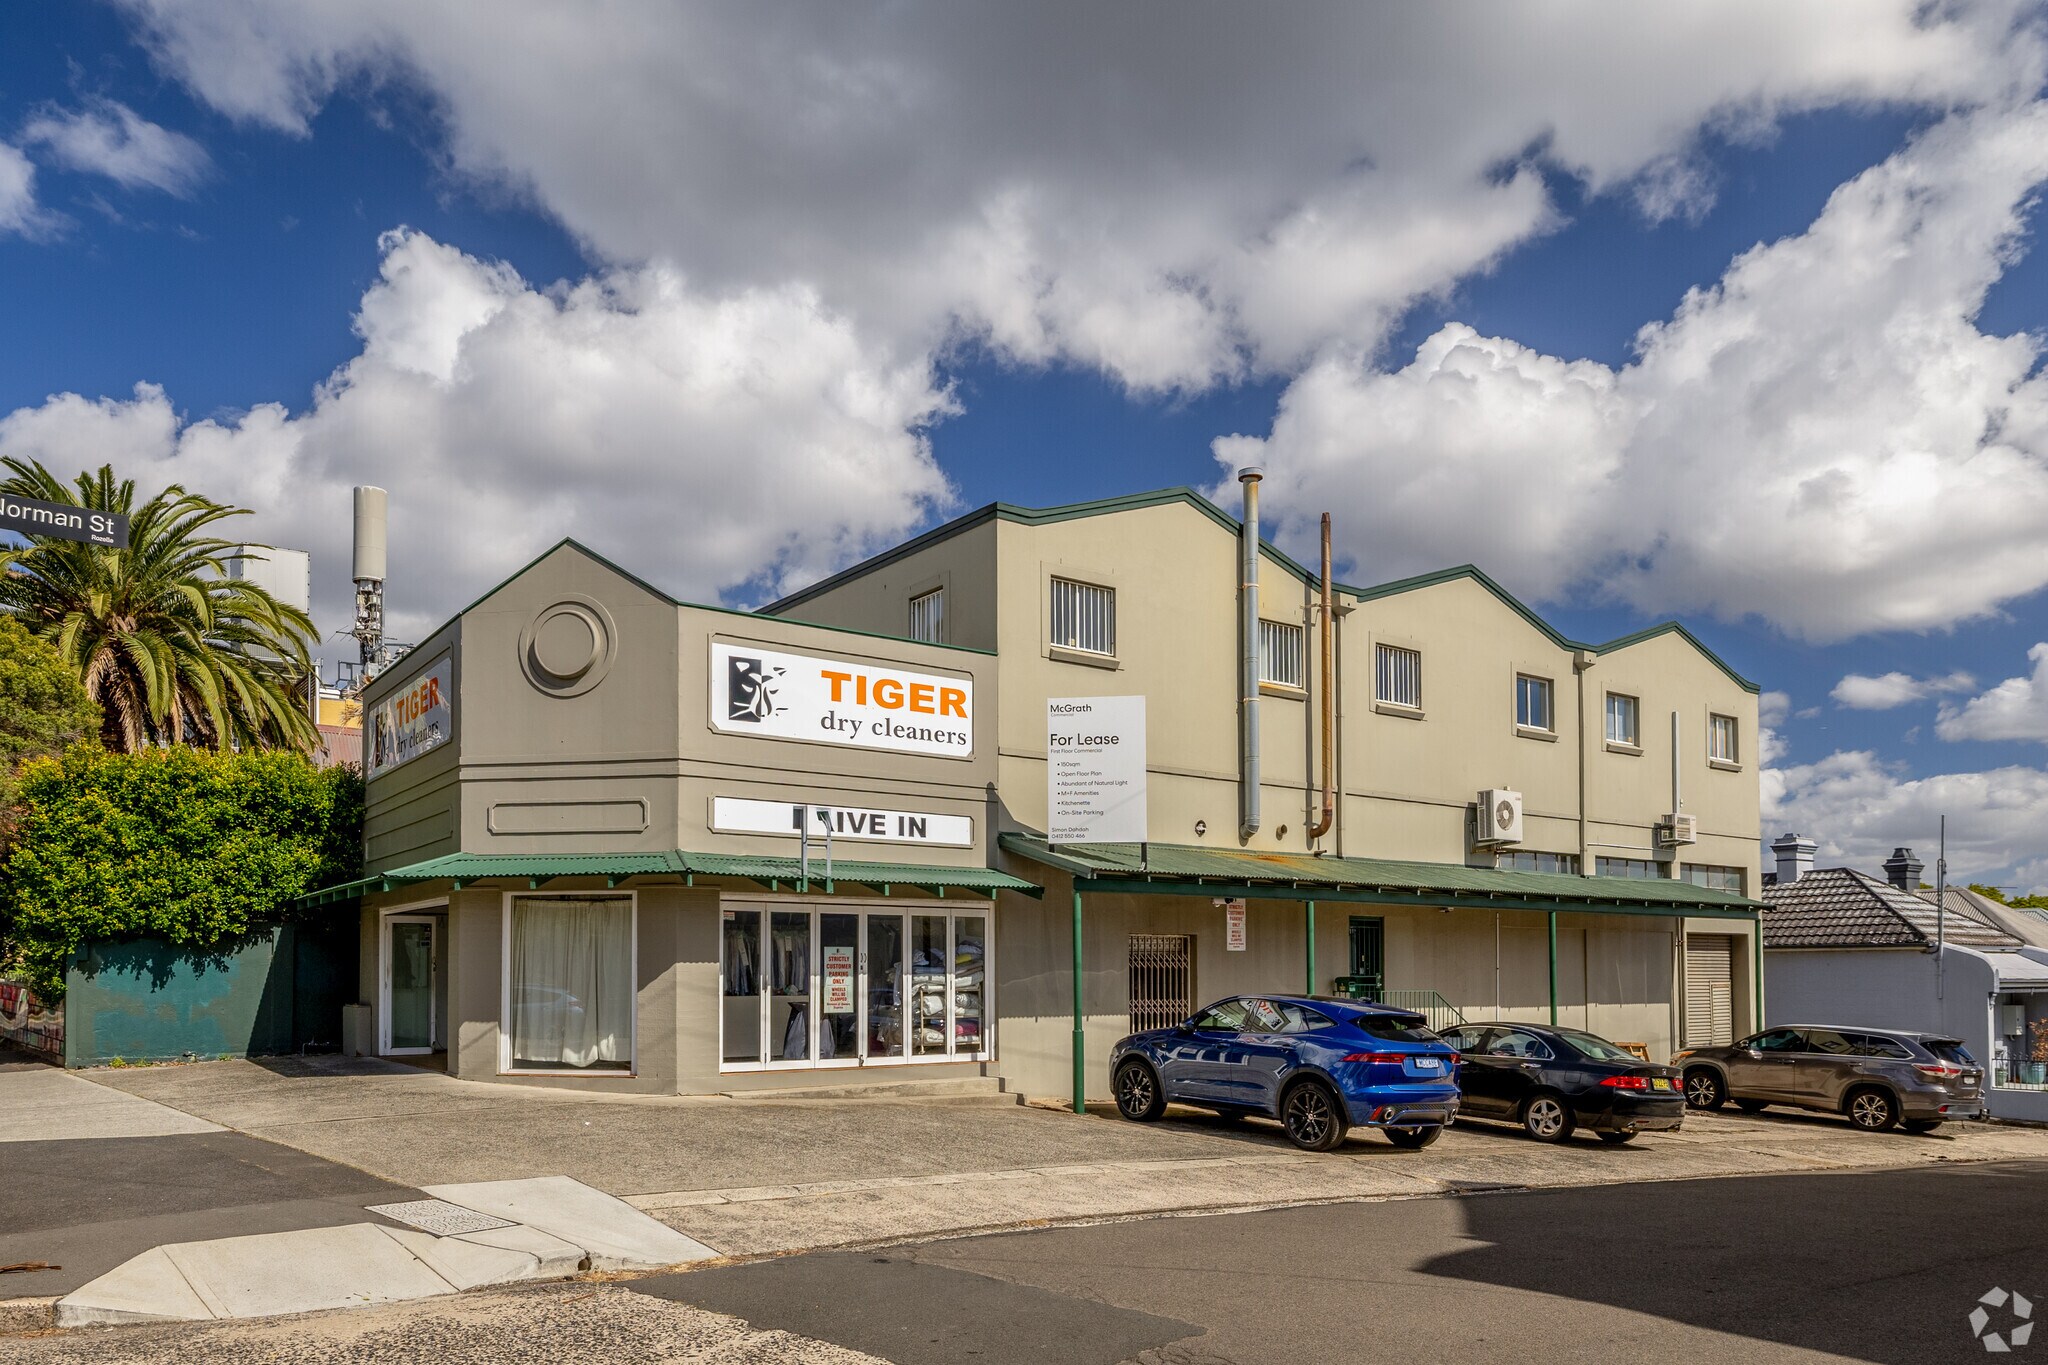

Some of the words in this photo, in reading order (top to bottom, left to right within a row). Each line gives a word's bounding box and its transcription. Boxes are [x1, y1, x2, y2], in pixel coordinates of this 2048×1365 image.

[89, 515, 115, 535] St
[91, 534, 115, 544] Rozelle
[396, 676, 440, 728] TIGER
[820, 670, 968, 718] TIGER
[1050, 703, 1092, 713] McGrath
[409, 720, 440, 749] cleaners
[820, 711, 863, 739] dry
[871, 718, 967, 746] cleaners
[1050, 733, 1073, 746] For
[1077, 733, 1120, 746] Lease
[898, 813, 927, 838] IN
